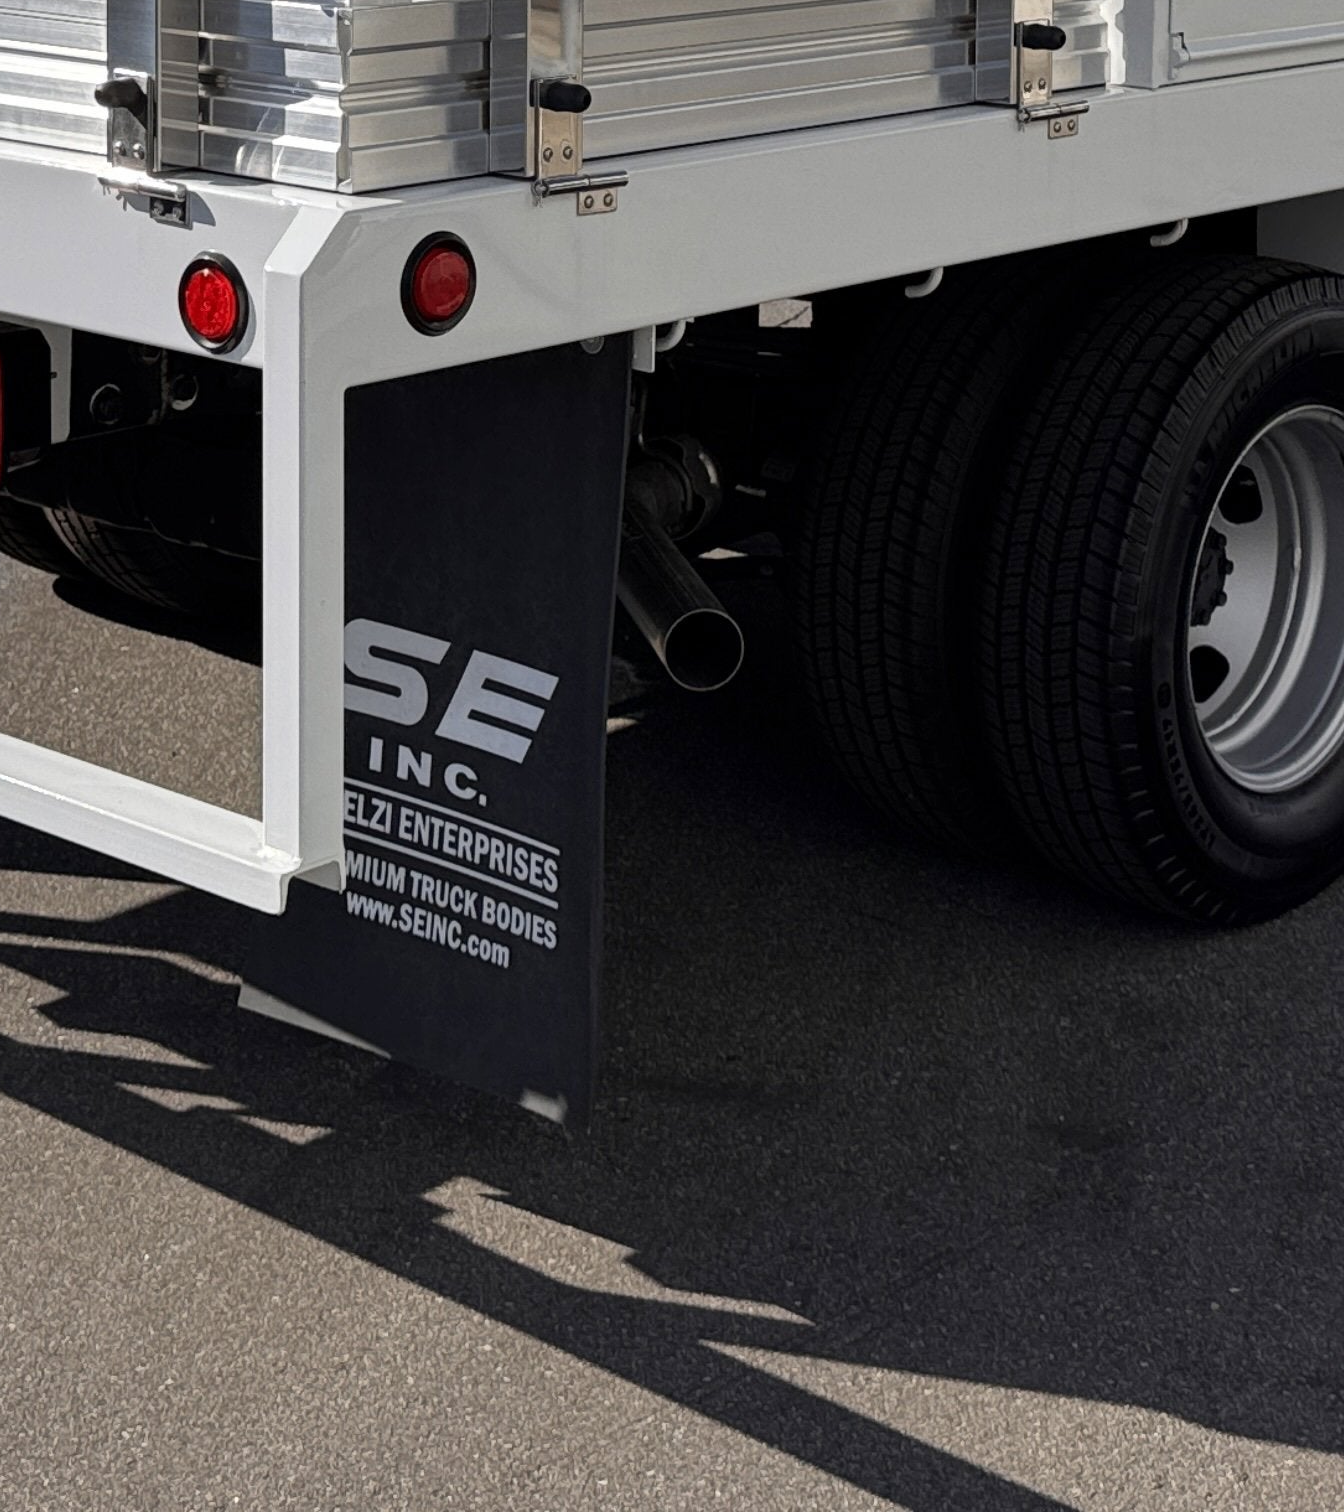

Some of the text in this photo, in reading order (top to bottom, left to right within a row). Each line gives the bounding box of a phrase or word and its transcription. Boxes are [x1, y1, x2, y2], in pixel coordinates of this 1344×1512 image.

[343, 617, 560, 765] SE
[368, 736, 488, 808] INC.
[398, 805, 559, 894] ENTERPRISES
[346, 890, 511, 969] www.SEINC.com
[409, 869, 479, 920] TRUCK
[481, 895, 558, 951] BODIES
